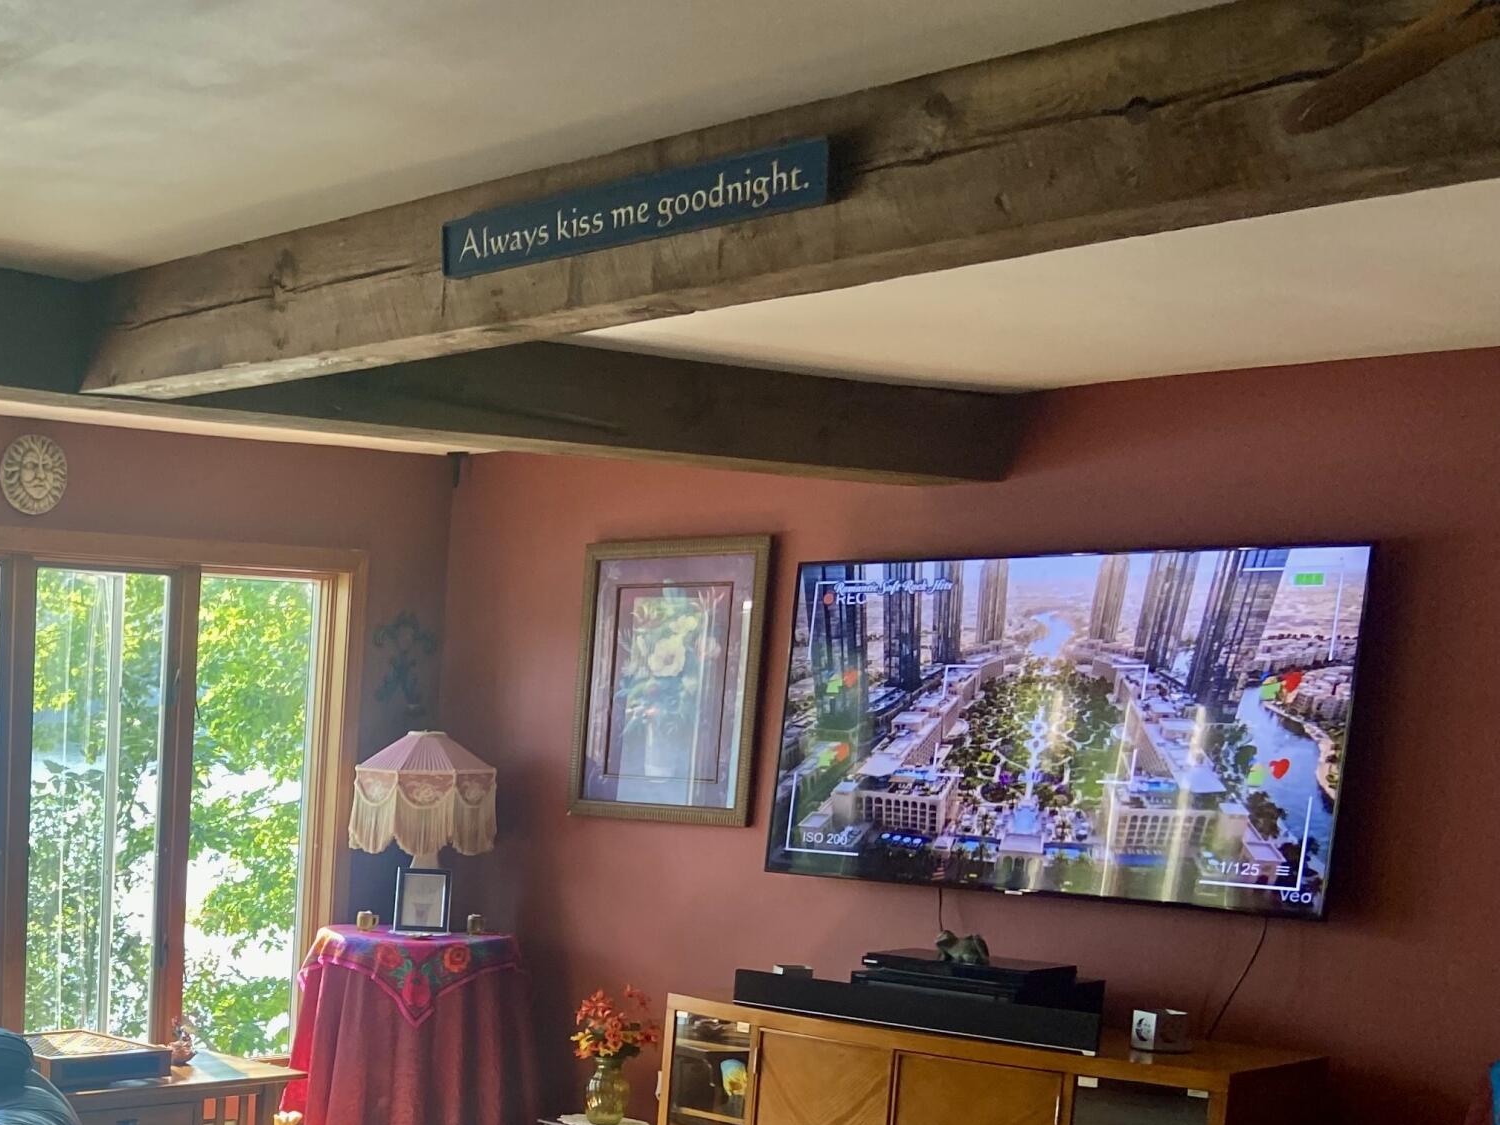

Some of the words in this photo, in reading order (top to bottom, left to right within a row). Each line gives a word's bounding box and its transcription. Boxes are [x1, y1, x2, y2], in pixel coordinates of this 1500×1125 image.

[458, 223, 549, 263] Always
[557, 207, 604, 242] kiss
[611, 202, 650, 229] me
[656, 158, 810, 228] goodnight.
[836, 592, 867, 605] REC
[802, 831, 824, 844] ISO
[826, 833, 848, 845] 200
[1220, 861, 1261, 876] 1/125
